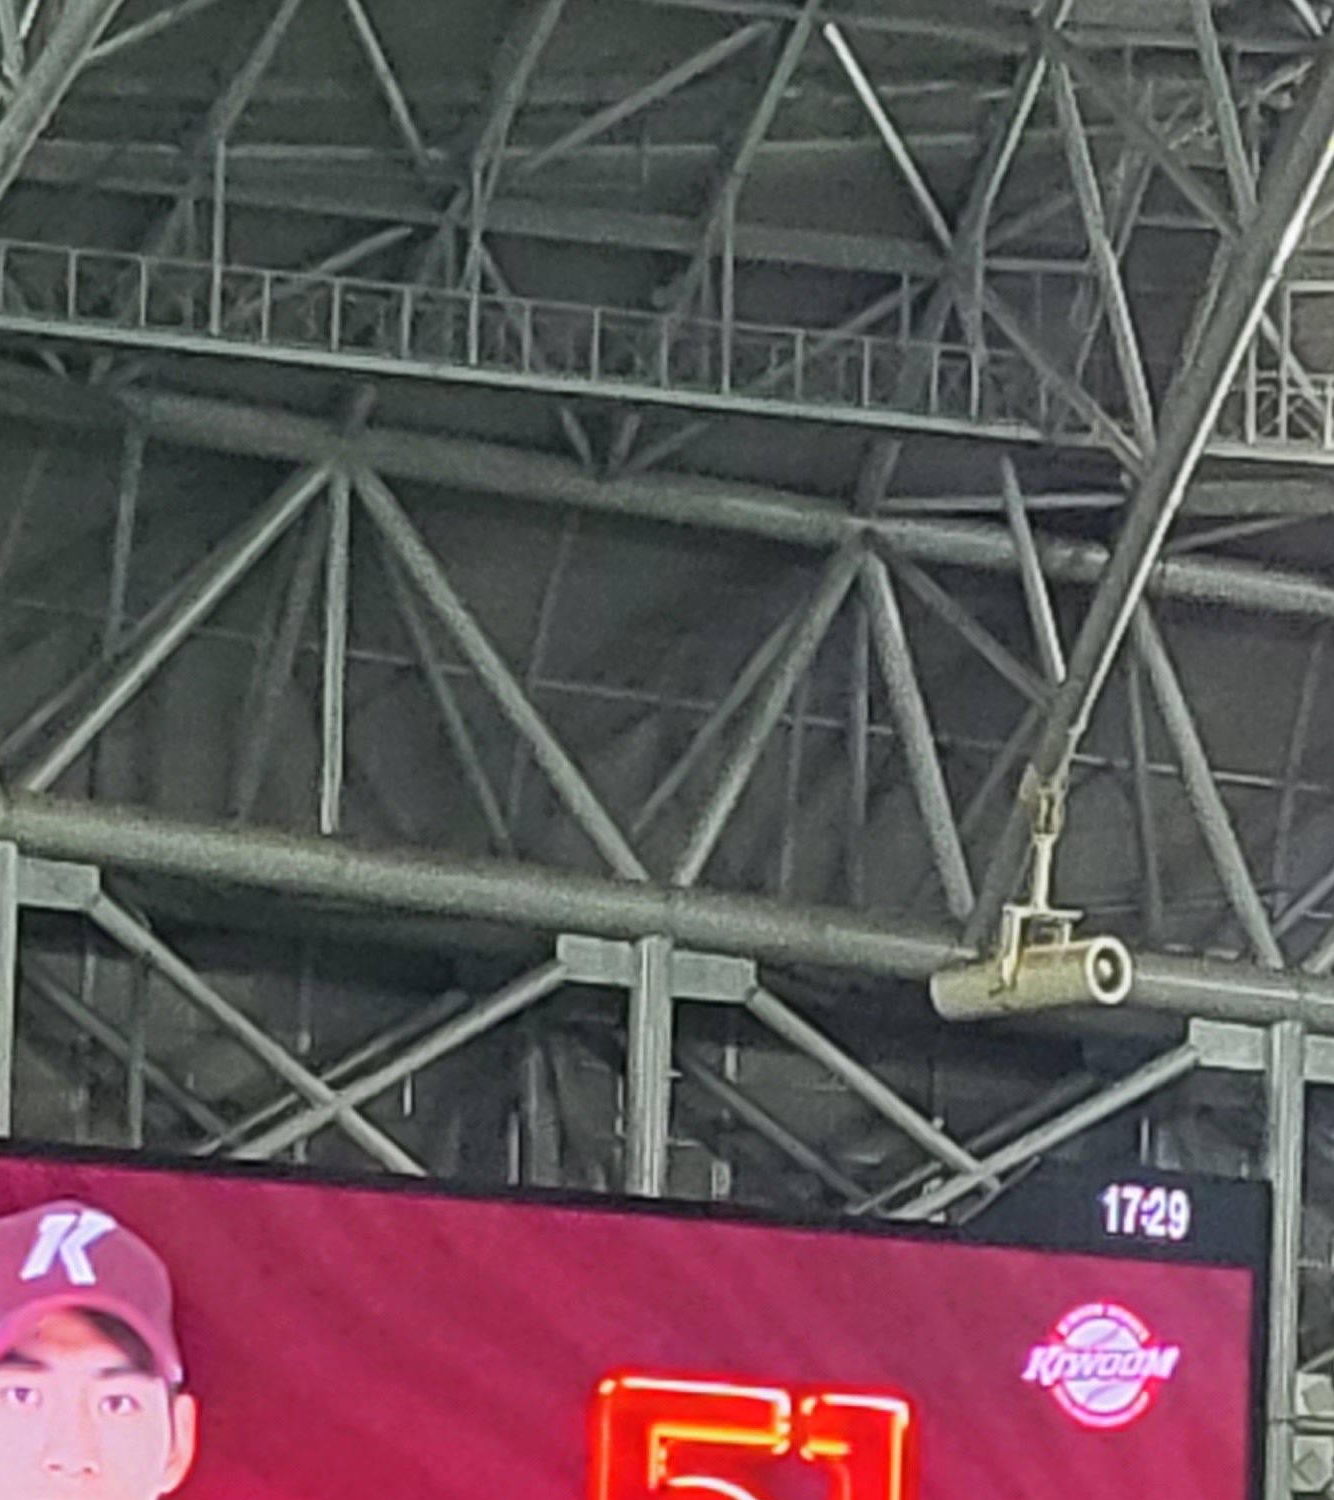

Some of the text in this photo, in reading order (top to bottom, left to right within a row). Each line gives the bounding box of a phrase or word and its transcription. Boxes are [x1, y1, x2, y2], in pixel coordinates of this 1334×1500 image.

[1101, 1184, 1190, 1240] 17:29
[20, 1211, 116, 1285] K
[1021, 1345, 1180, 1386] KIWOOM
